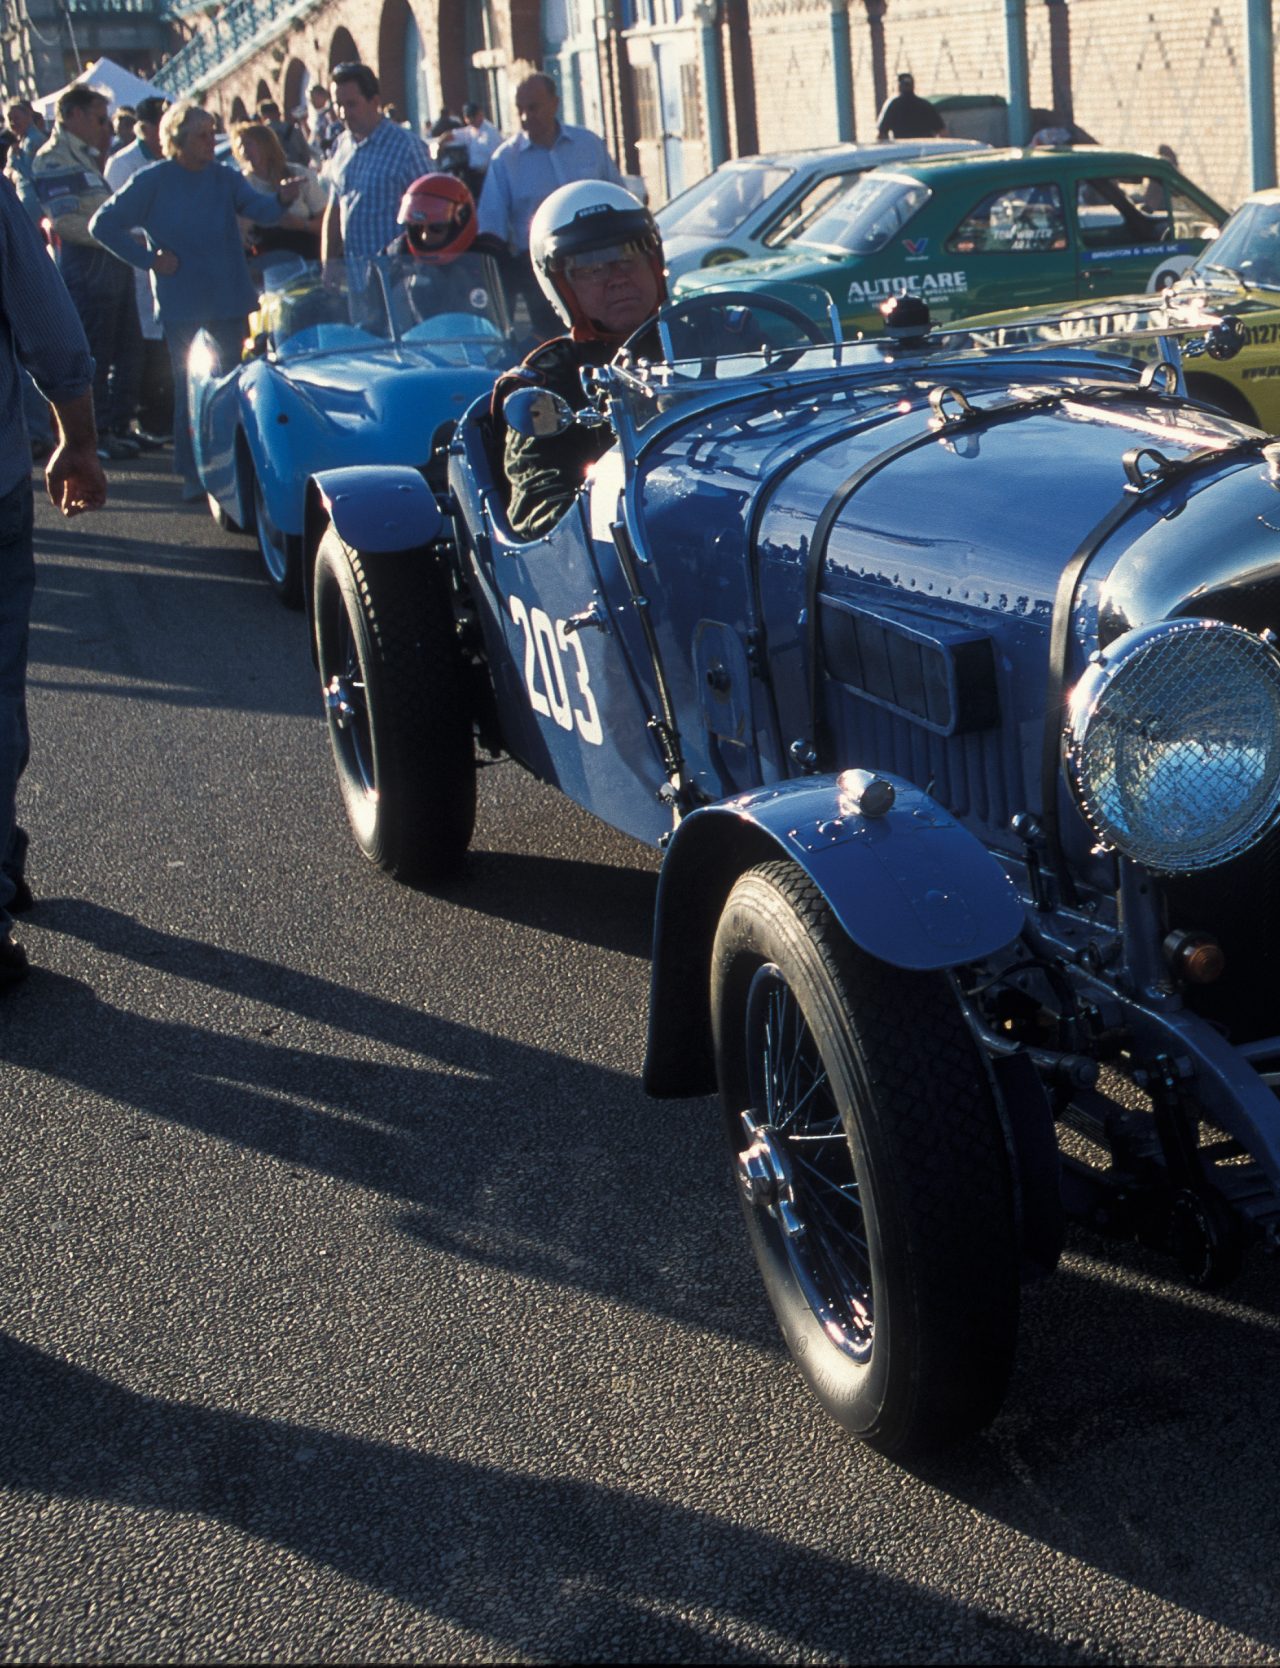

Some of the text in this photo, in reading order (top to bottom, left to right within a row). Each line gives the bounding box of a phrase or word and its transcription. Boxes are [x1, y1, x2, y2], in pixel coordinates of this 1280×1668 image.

[1091, 248, 1131, 259] BRIGHTON
[848, 271, 967, 297] AUTOCARE
[510, 595, 604, 746] 203
